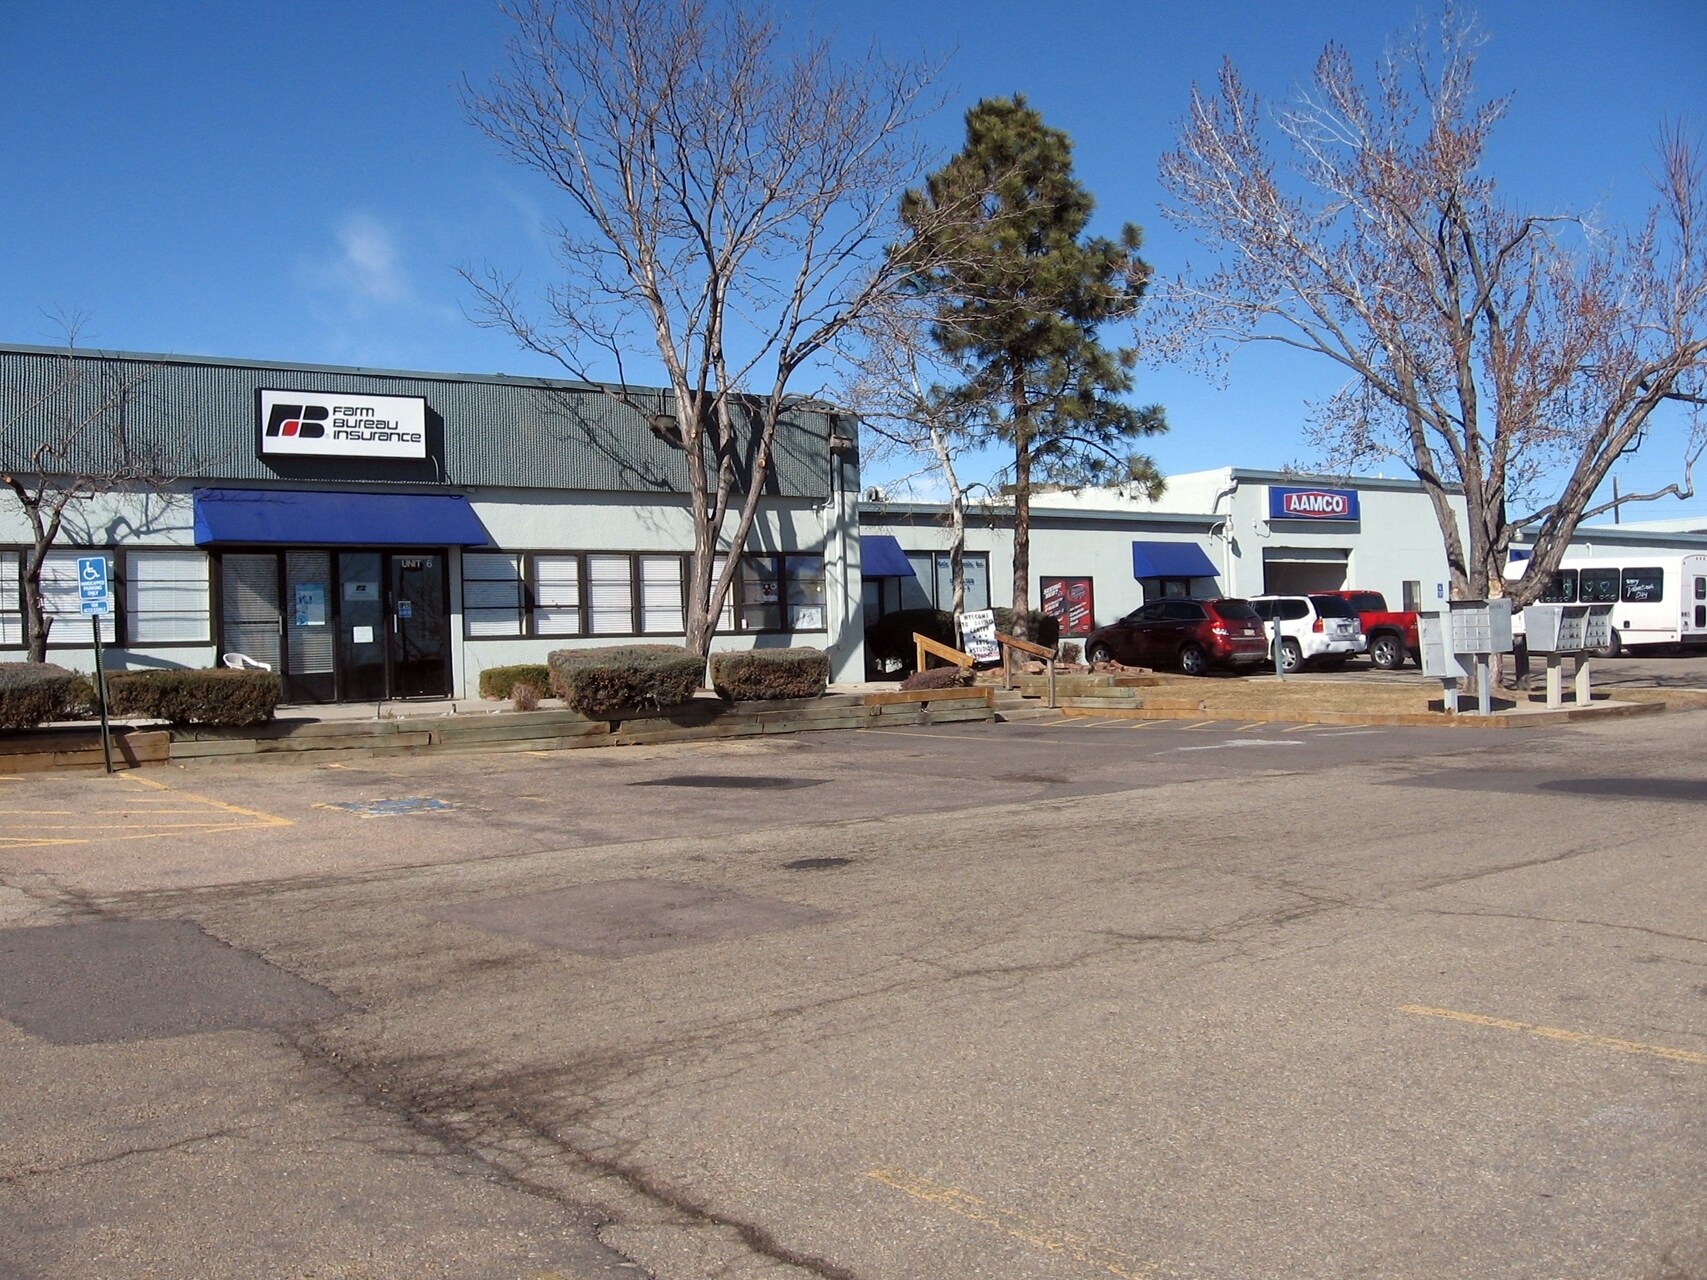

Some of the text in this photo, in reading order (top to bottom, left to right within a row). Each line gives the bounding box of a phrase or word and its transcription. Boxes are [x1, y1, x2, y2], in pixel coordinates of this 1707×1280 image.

[1290, 494, 1344, 512] AAMCO
[401, 559, 433, 568] UNIT 6
